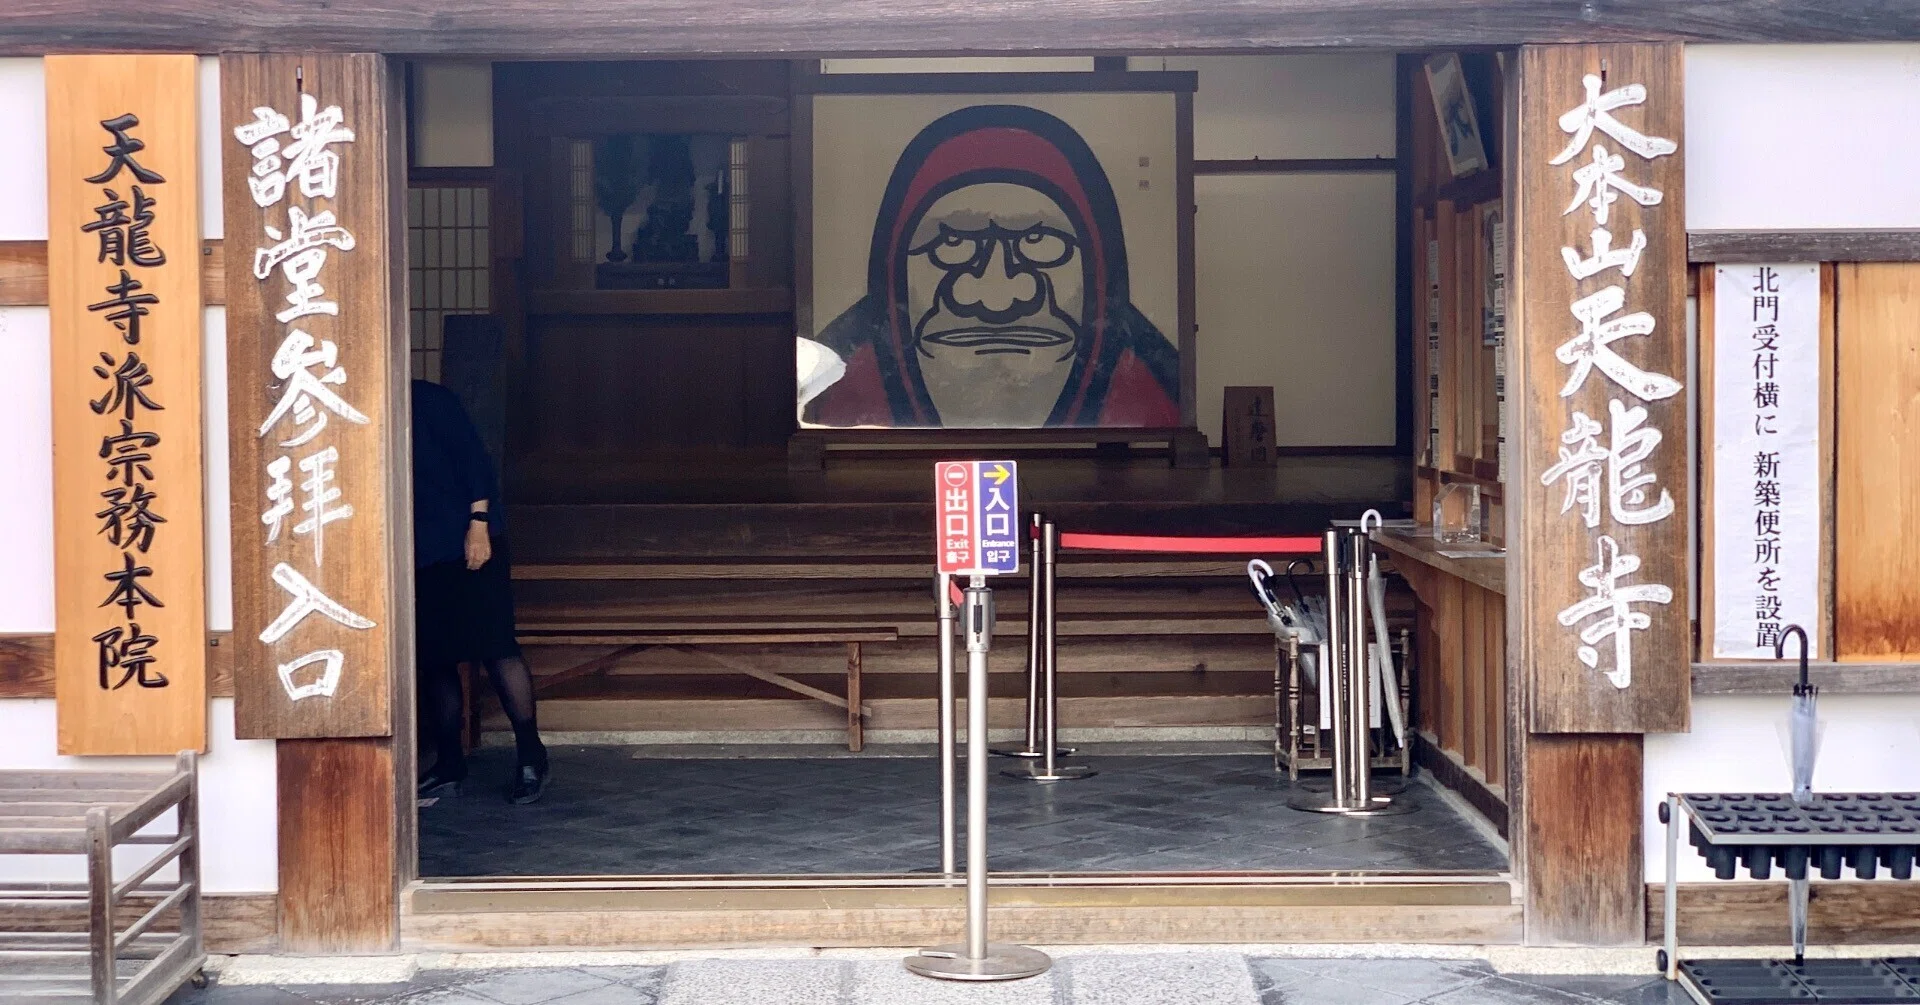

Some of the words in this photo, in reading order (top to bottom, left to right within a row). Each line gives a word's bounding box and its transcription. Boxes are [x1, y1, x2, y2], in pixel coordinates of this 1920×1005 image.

[82, 113, 168, 692] 天龍寺派宗務本院
[234, 94, 377, 702] 諸堂参拝入口
[1541, 74, 1683, 690] 大本山天龍寺
[1752, 266, 1780, 436] 北門受付横に
[945, 487, 968, 537] 出口
[946, 539, 969, 550] Exit
[982, 540, 1015, 548] Entrance
[984, 487, 1010, 536] 入口
[986, 550, 1011, 563] 입구
[1753, 451, 1782, 648] 新築便所を設置
